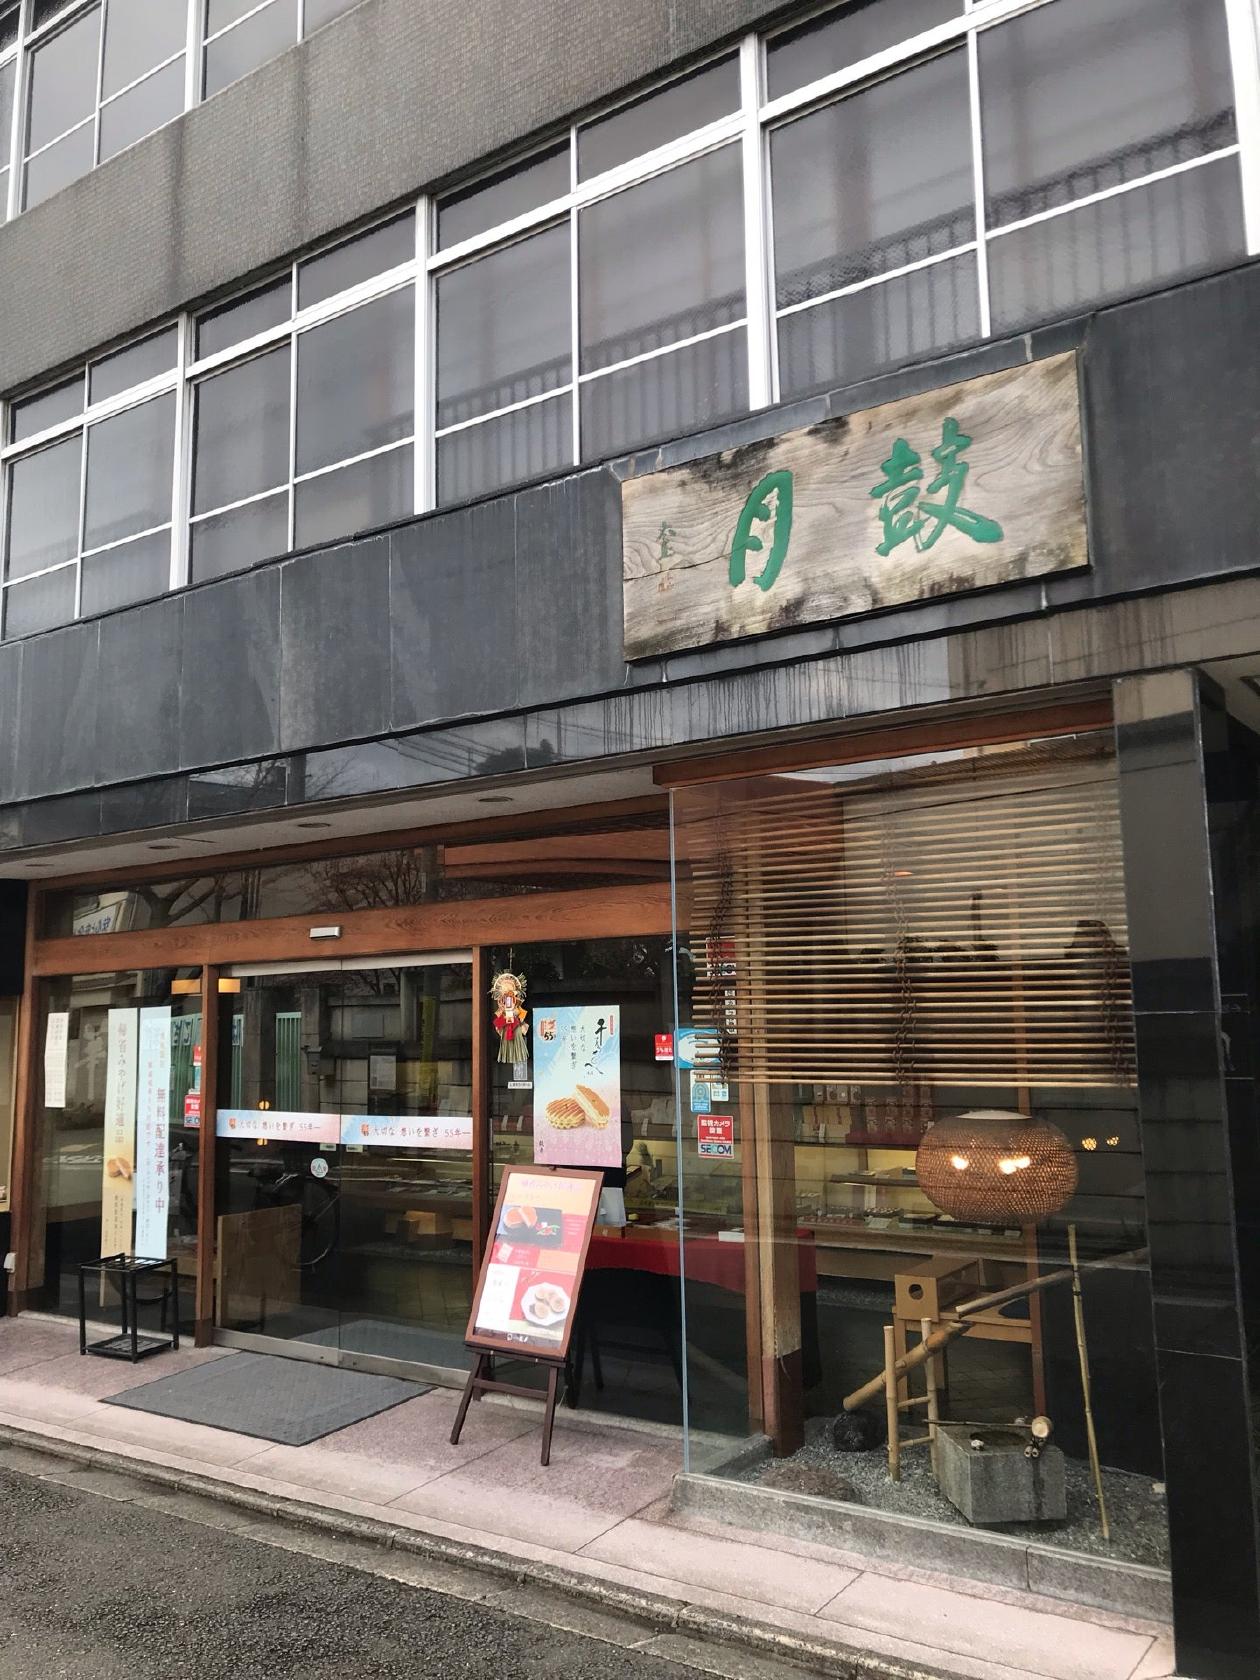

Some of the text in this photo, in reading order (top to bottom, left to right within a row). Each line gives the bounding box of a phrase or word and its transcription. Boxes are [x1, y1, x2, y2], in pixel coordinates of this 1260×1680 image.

[729, 416, 1005, 592] 鼓月
[154, 1087, 166, 1213] 無料配達承り中
[701, 1144, 732, 1155] SECOM
